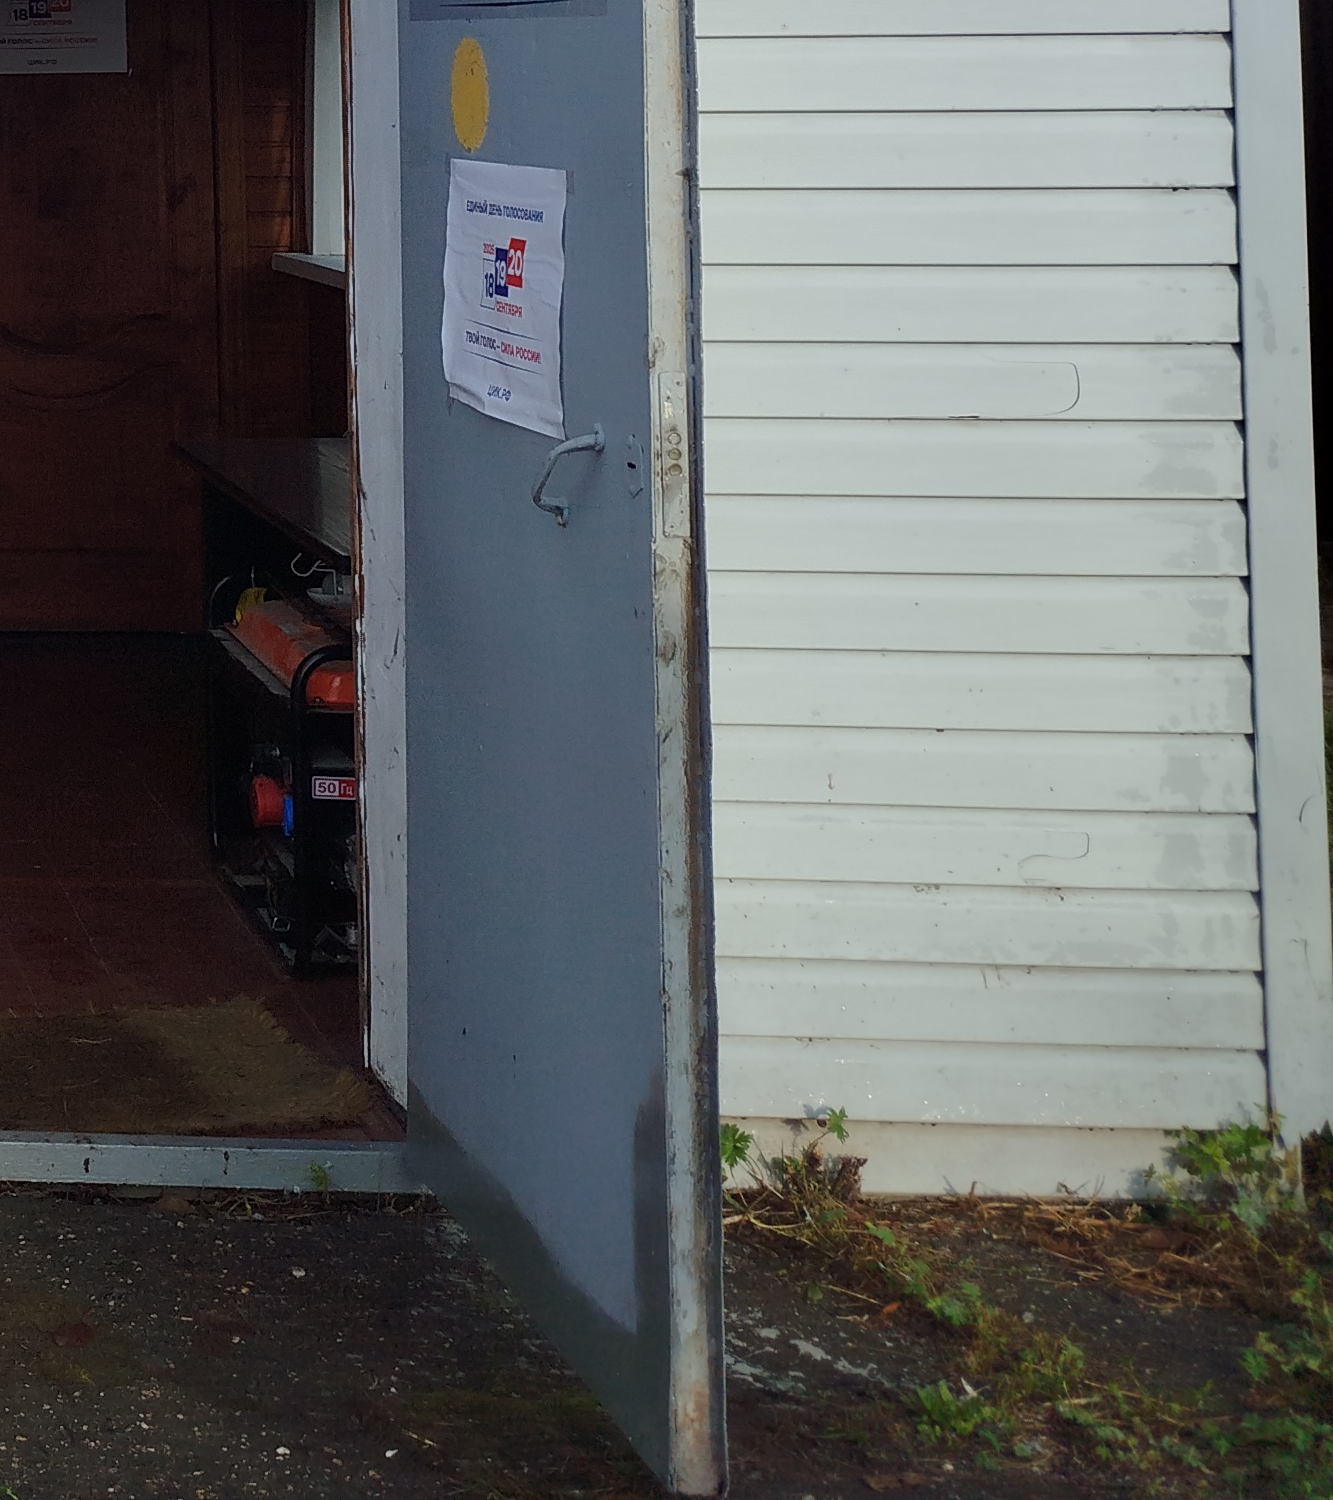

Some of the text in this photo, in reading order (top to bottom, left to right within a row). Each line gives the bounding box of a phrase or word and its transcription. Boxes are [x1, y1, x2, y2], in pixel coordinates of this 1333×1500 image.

[12, 8, 29, 21] 18
[30, 1, 47, 14] 19
[484, 248, 523, 298] 18 19 20
[317, 781, 337, 794] 50
